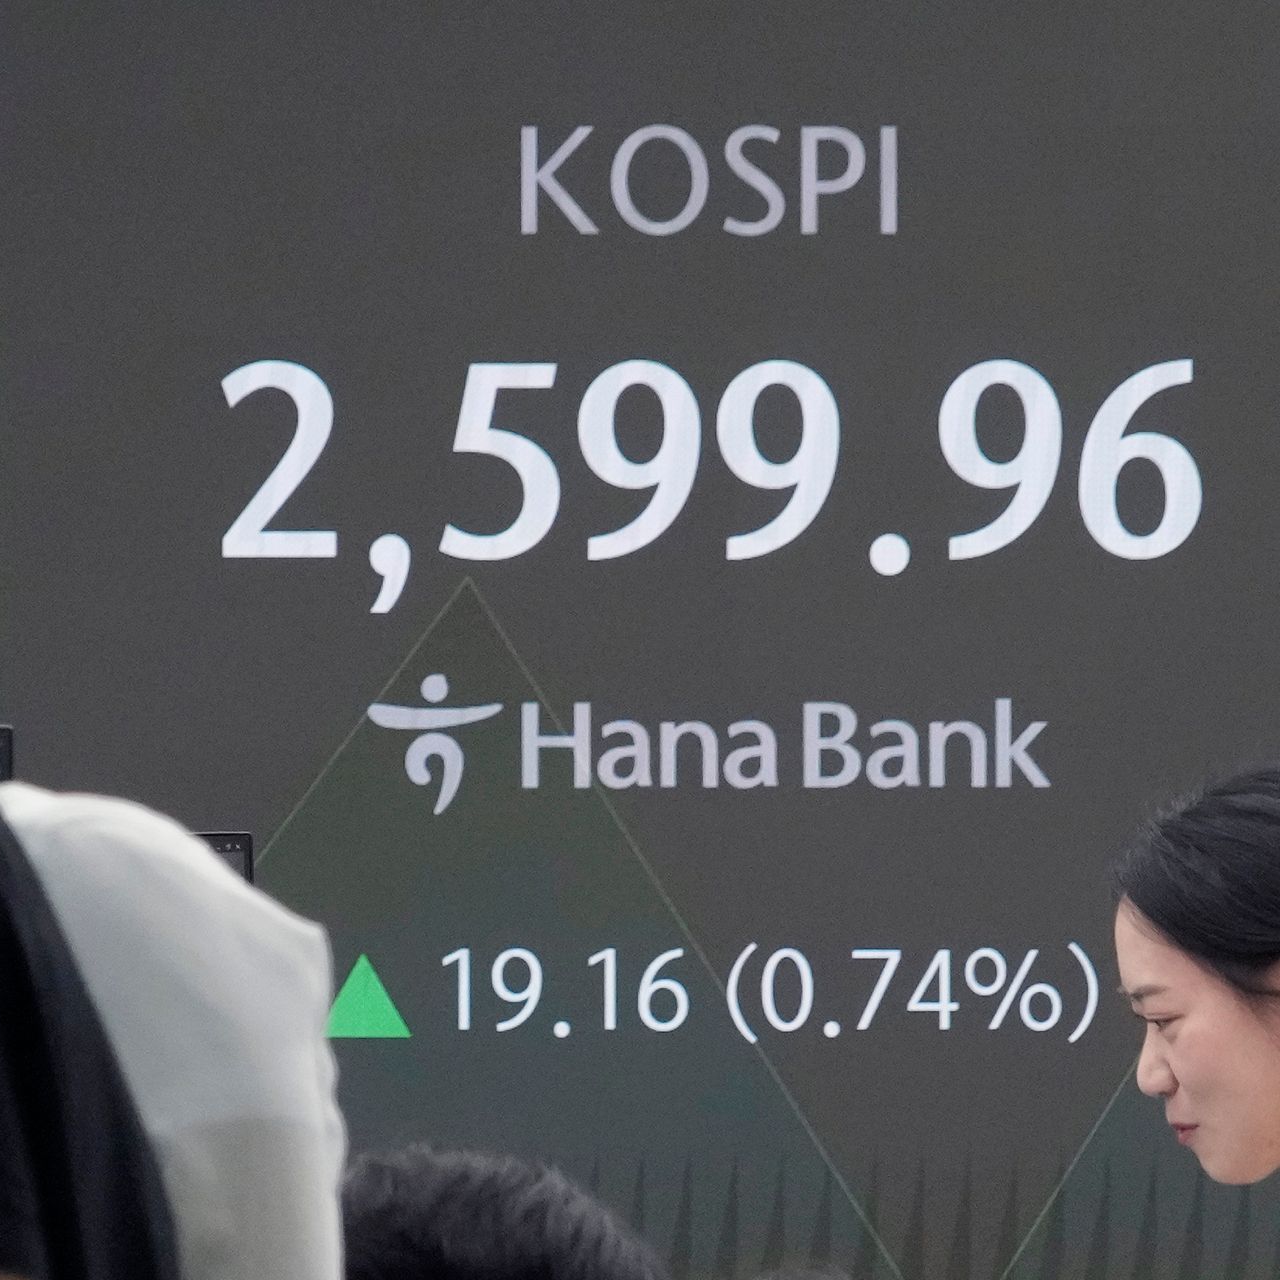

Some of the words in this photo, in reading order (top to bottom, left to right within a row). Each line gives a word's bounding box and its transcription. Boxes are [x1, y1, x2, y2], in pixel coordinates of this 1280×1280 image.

[520, 125, 898, 237] KOSPI
[220, 358, 1203, 614] 2,599.96
[521, 702, 778, 790] Hana
[803, 697, 1051, 789] Bank
[441, 947, 690, 1038] 19.16
[726, 942, 1099, 1044] (0.74%)
